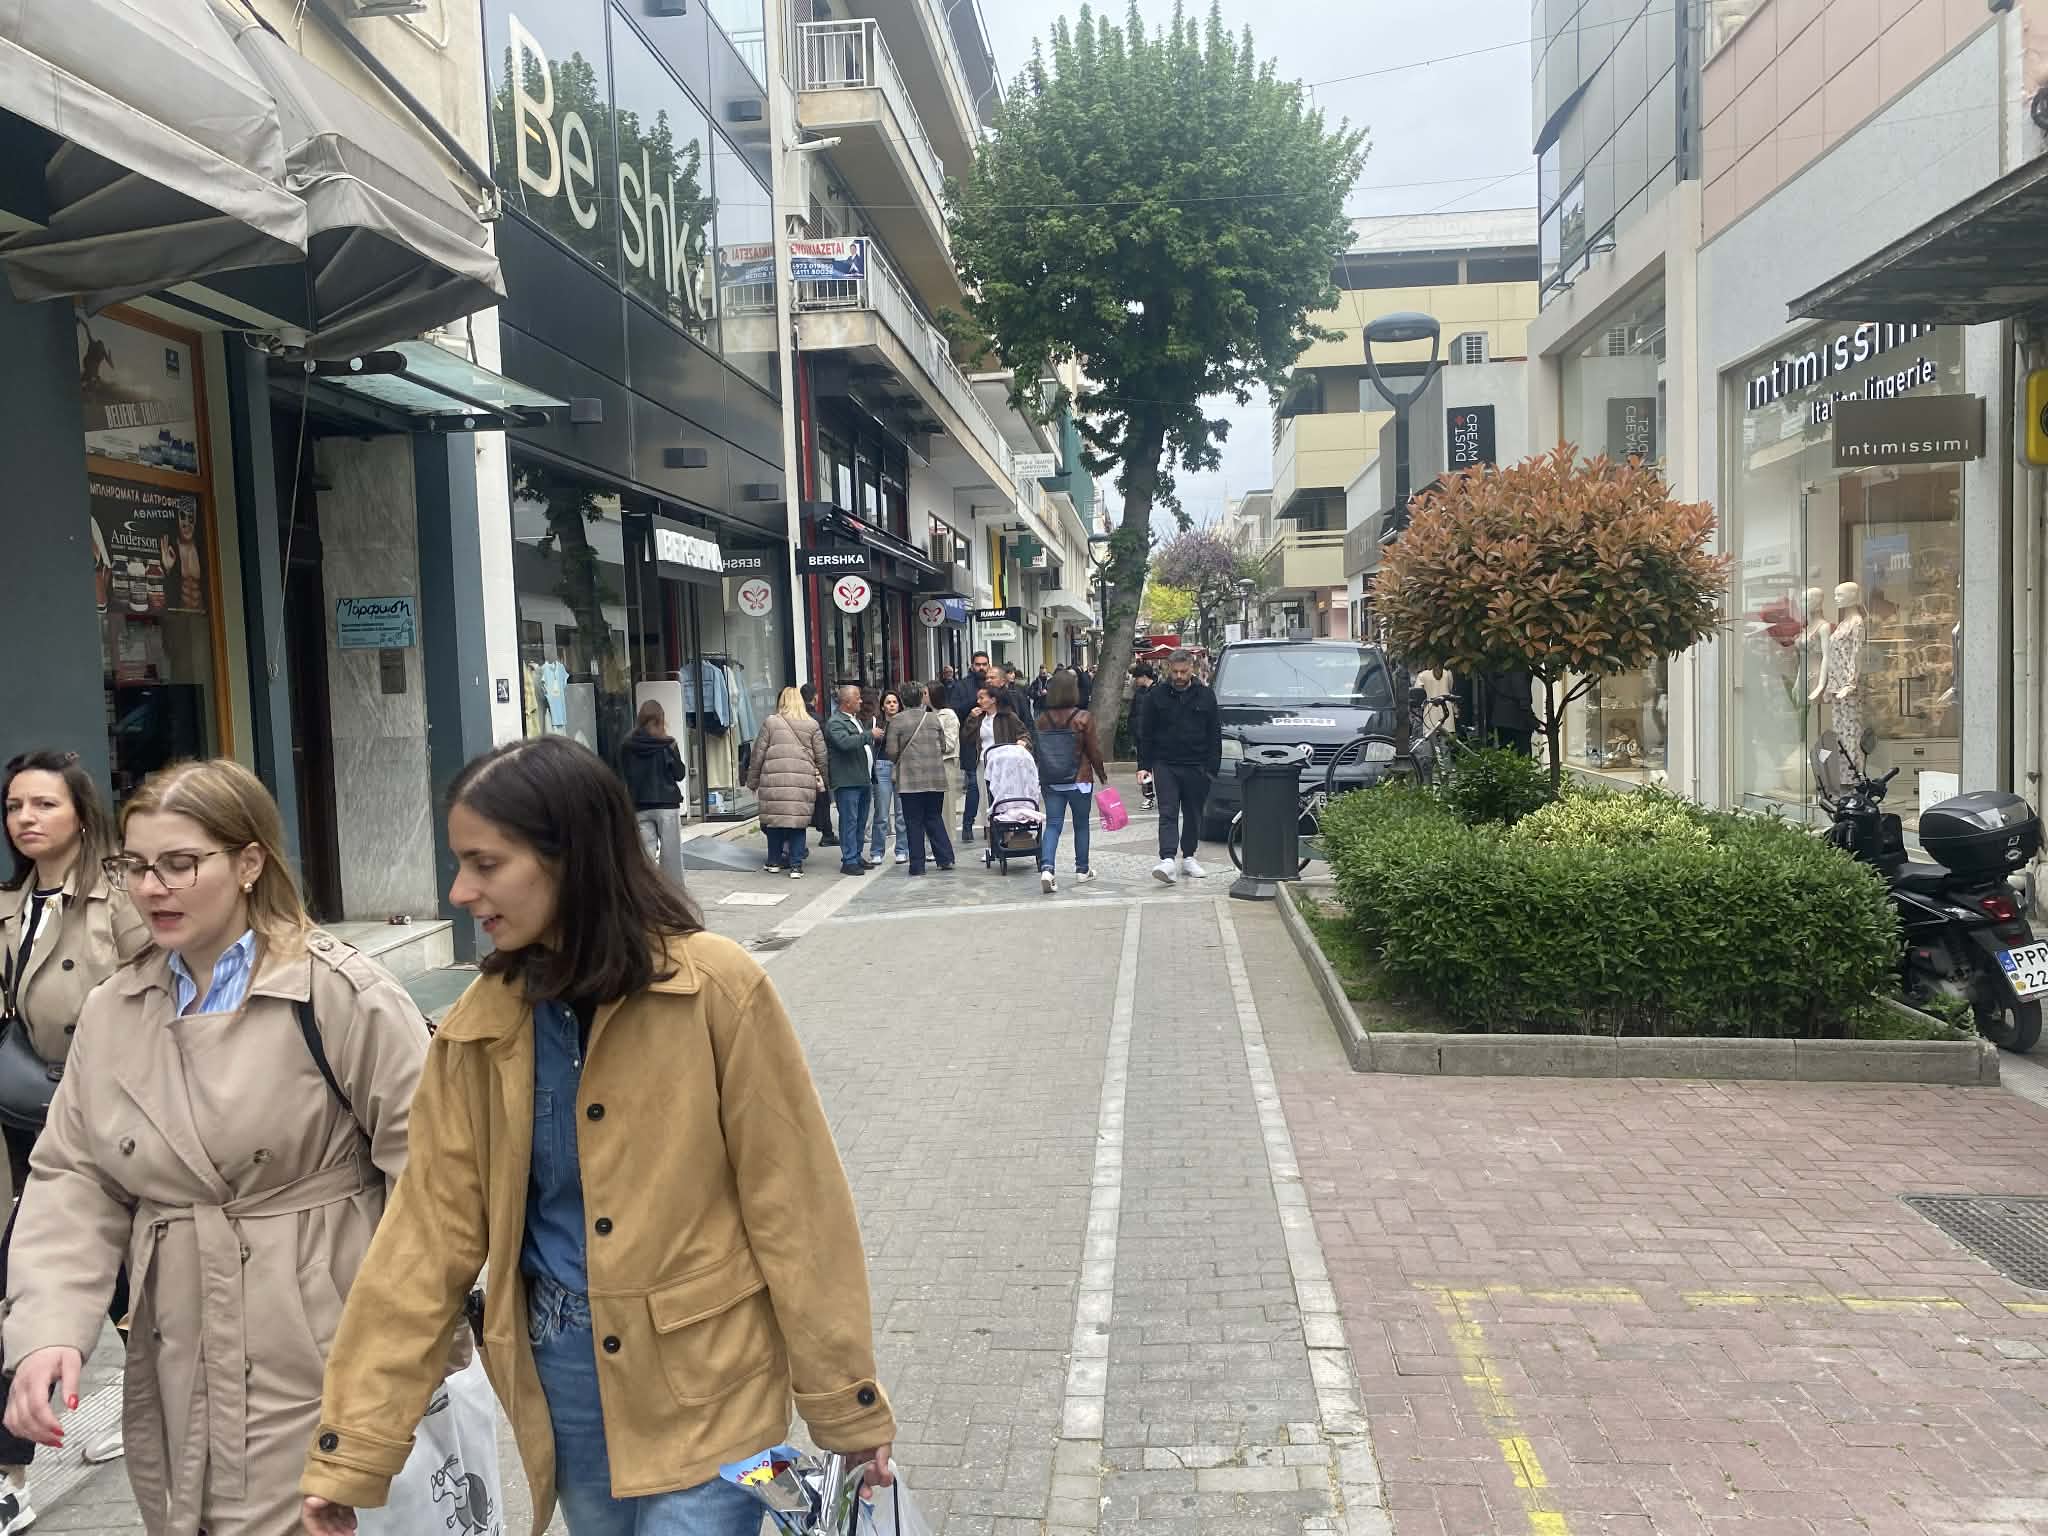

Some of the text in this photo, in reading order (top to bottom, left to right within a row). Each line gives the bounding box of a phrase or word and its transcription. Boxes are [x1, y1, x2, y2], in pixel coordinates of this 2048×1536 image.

[509, 12, 717, 322] Beshka
[1747, 322, 1931, 411] intimissi
[1811, 356, 1932, 424] Ital lingerie
[1455, 428, 1466, 462] DUST
[1466, 413, 1480, 462] CREAM
[111, 529, 158, 548] Anderson
[808, 554, 865, 566] BERSHKA
[2025, 970, 2048, 988] 22
